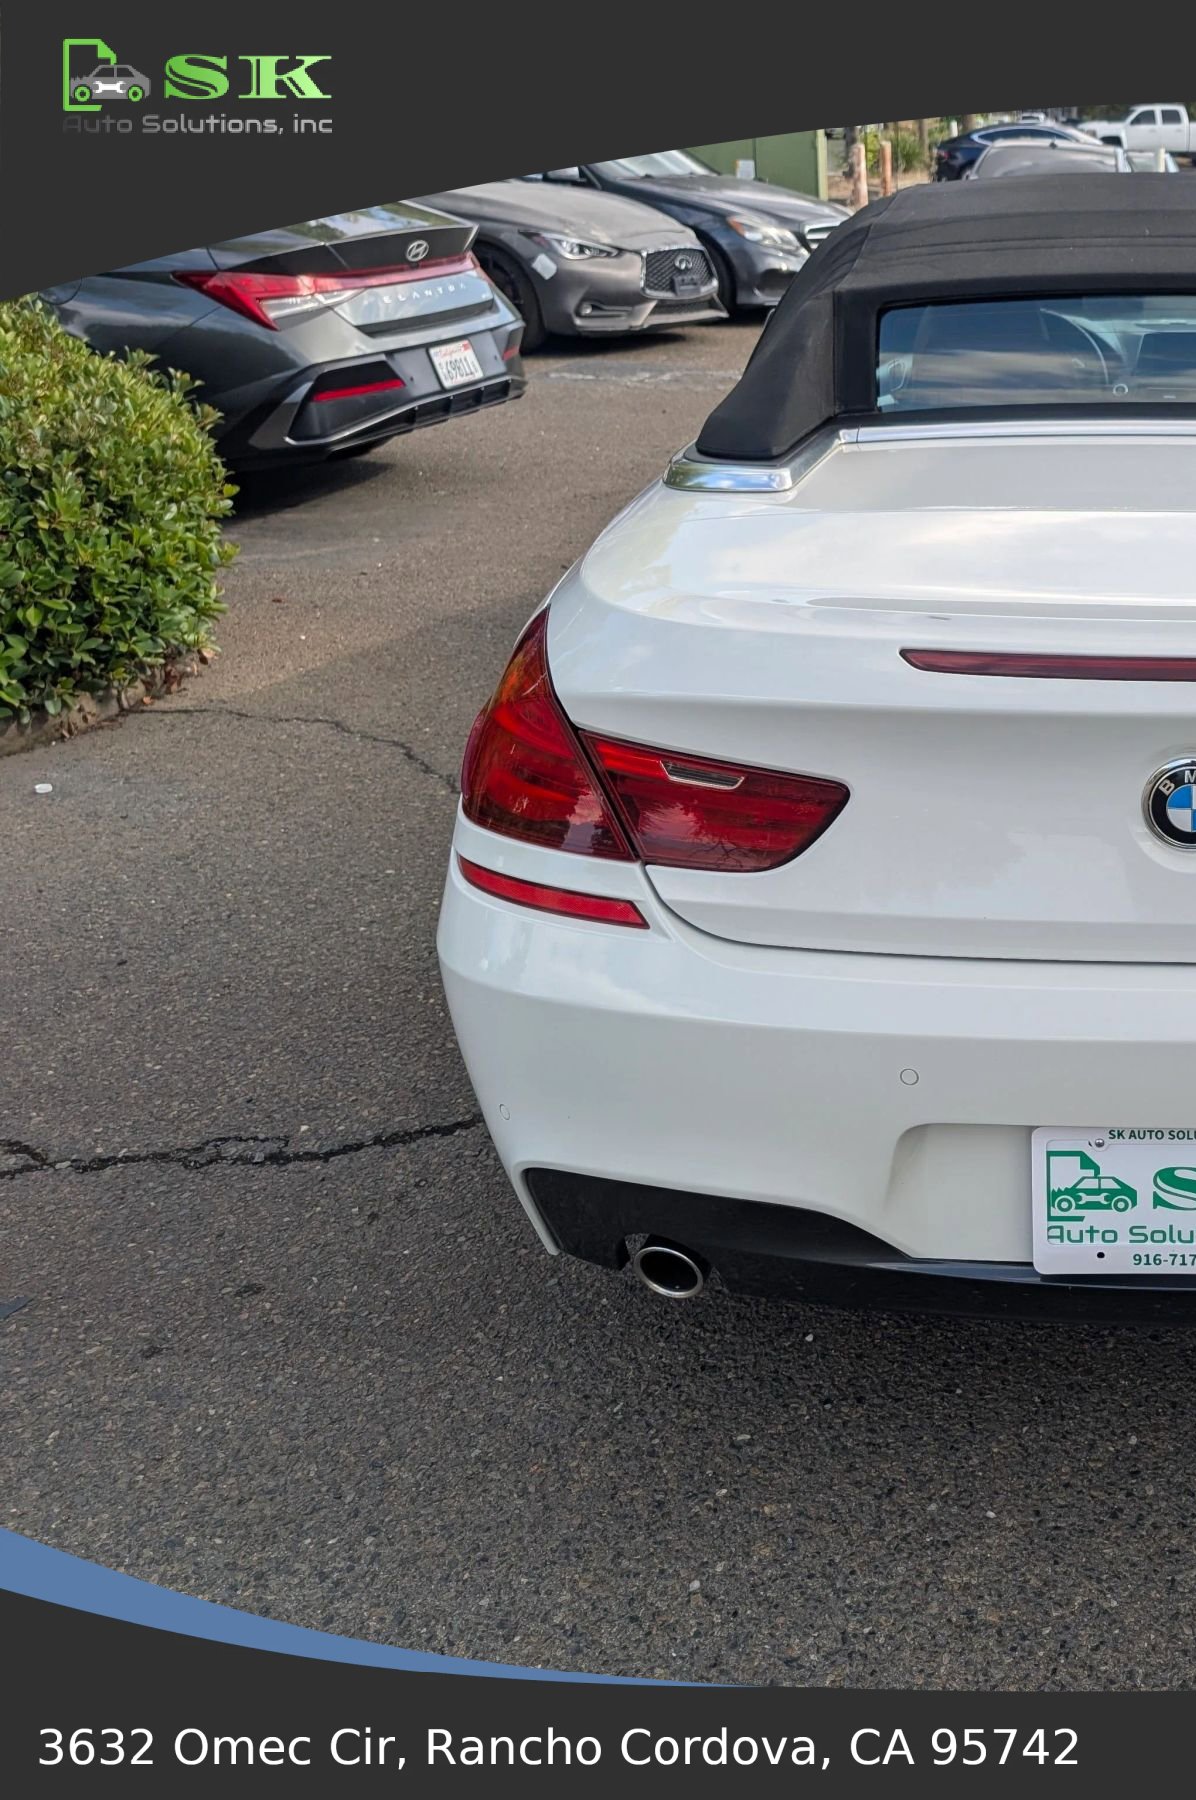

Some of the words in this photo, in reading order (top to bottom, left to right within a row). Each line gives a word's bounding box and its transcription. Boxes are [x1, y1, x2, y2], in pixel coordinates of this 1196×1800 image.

[1108, 1129, 1126, 1140] SK
[1128, 1129, 1165, 1141] AUTO
[1048, 1225, 1119, 1244] Auto
